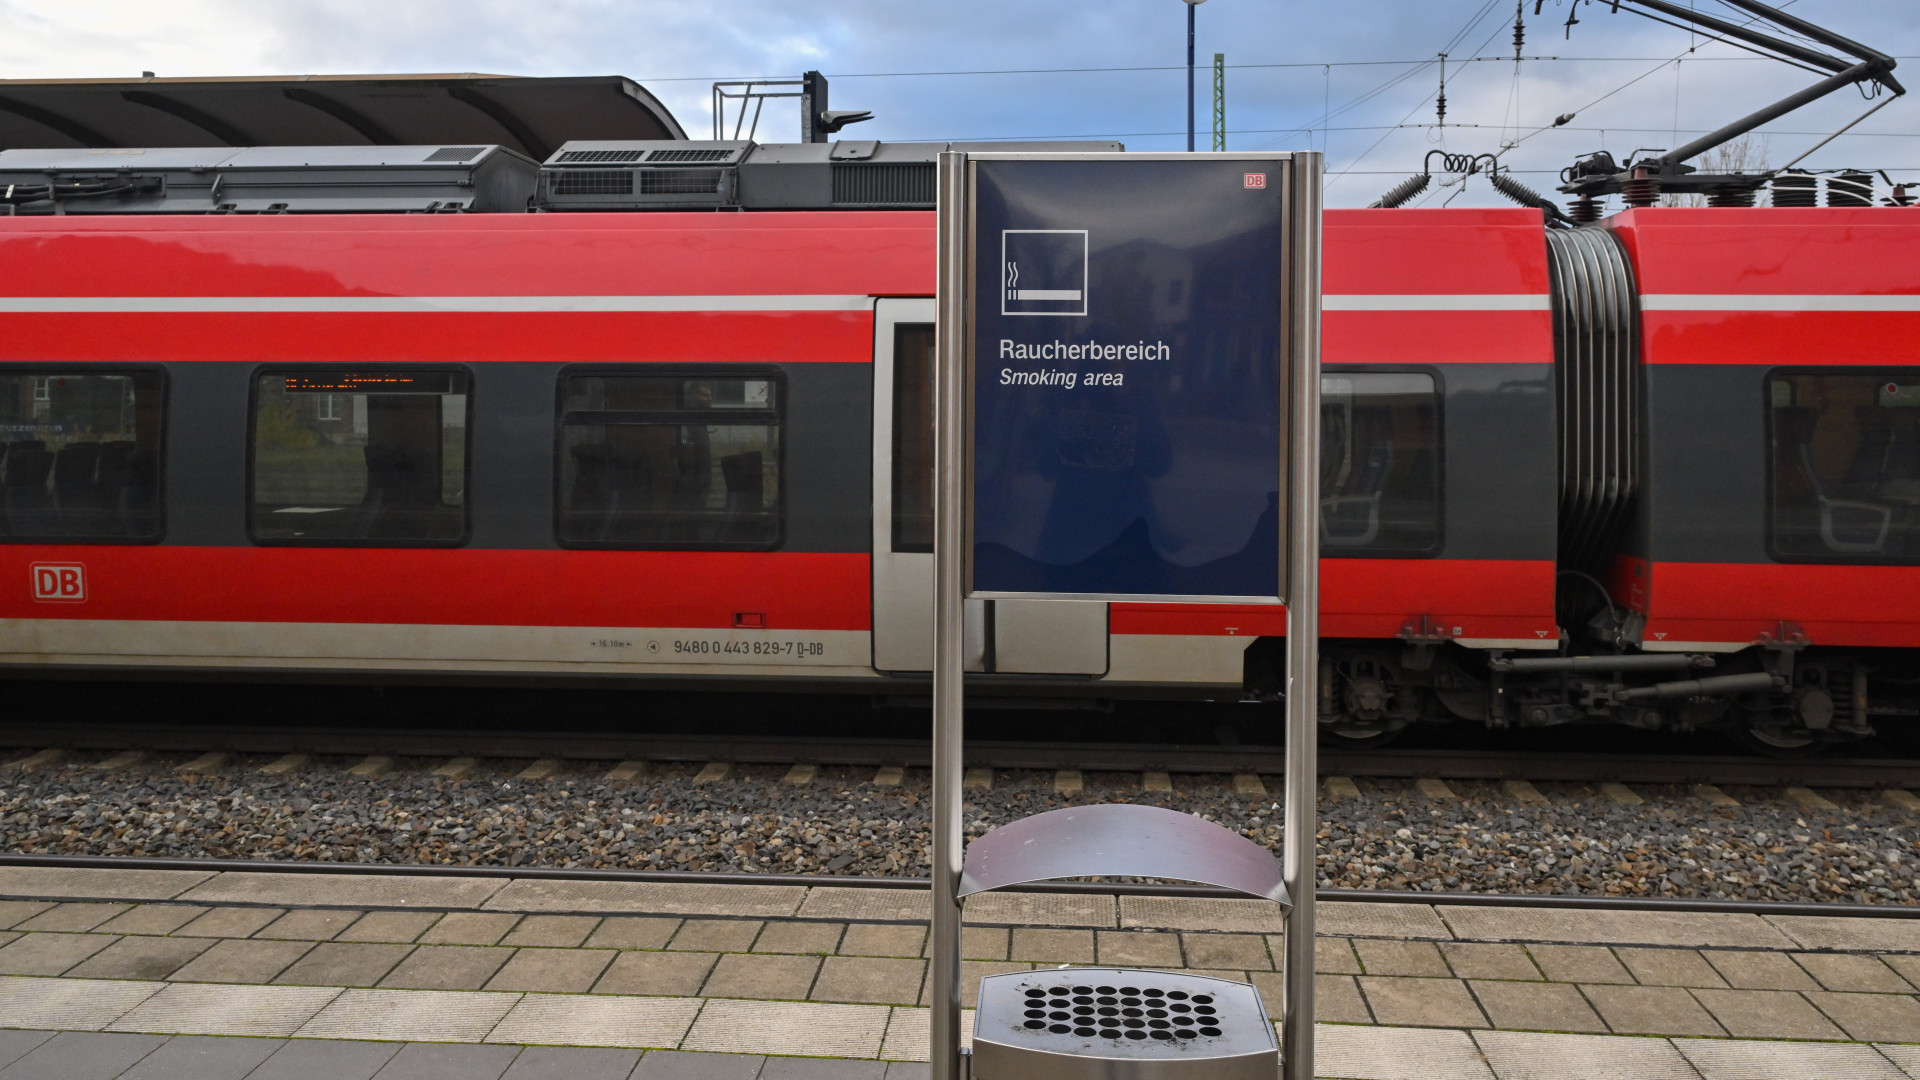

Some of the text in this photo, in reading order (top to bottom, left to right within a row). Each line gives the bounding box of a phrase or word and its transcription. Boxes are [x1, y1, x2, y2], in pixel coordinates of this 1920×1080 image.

[1246, 175, 1263, 186] DB
[999, 339, 1171, 361] Raucherbereich
[999, 367, 1124, 390] Smoking area
[37, 568, 81, 596] DB
[724, 641, 750, 655] 443
[753, 642, 793, 655] 829-7
[797, 642, 824, 659] D-DB
